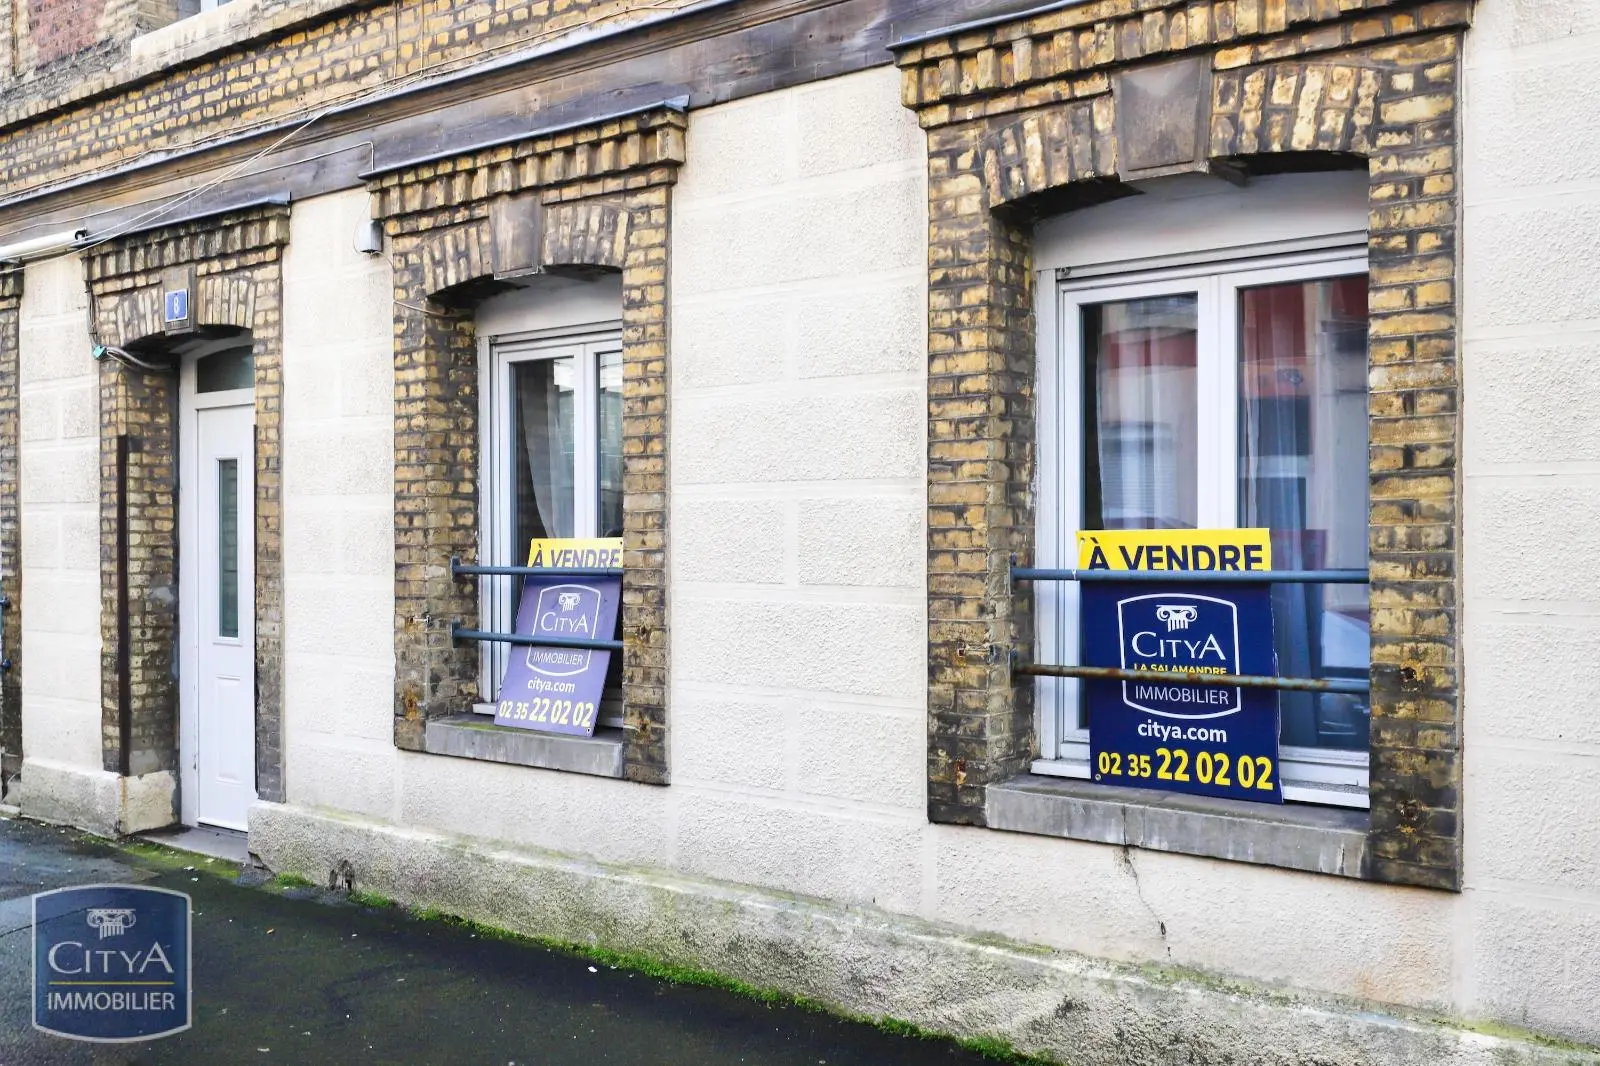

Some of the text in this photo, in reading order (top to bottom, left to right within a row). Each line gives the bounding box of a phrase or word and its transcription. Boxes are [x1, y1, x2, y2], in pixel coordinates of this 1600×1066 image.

[532, 543, 620, 568] À VENDRE
[1088, 537, 1263, 571] À VENDRE
[533, 652, 583, 665] IMMOBILIER
[527, 676, 575, 692] citya.com
[1135, 685, 1229, 705] IMMOBILIER
[499, 697, 594, 727] 02 35 22 02 02
[1137, 719, 1227, 743] citya.com
[1098, 748, 1273, 790] 02 35 22 02 02
